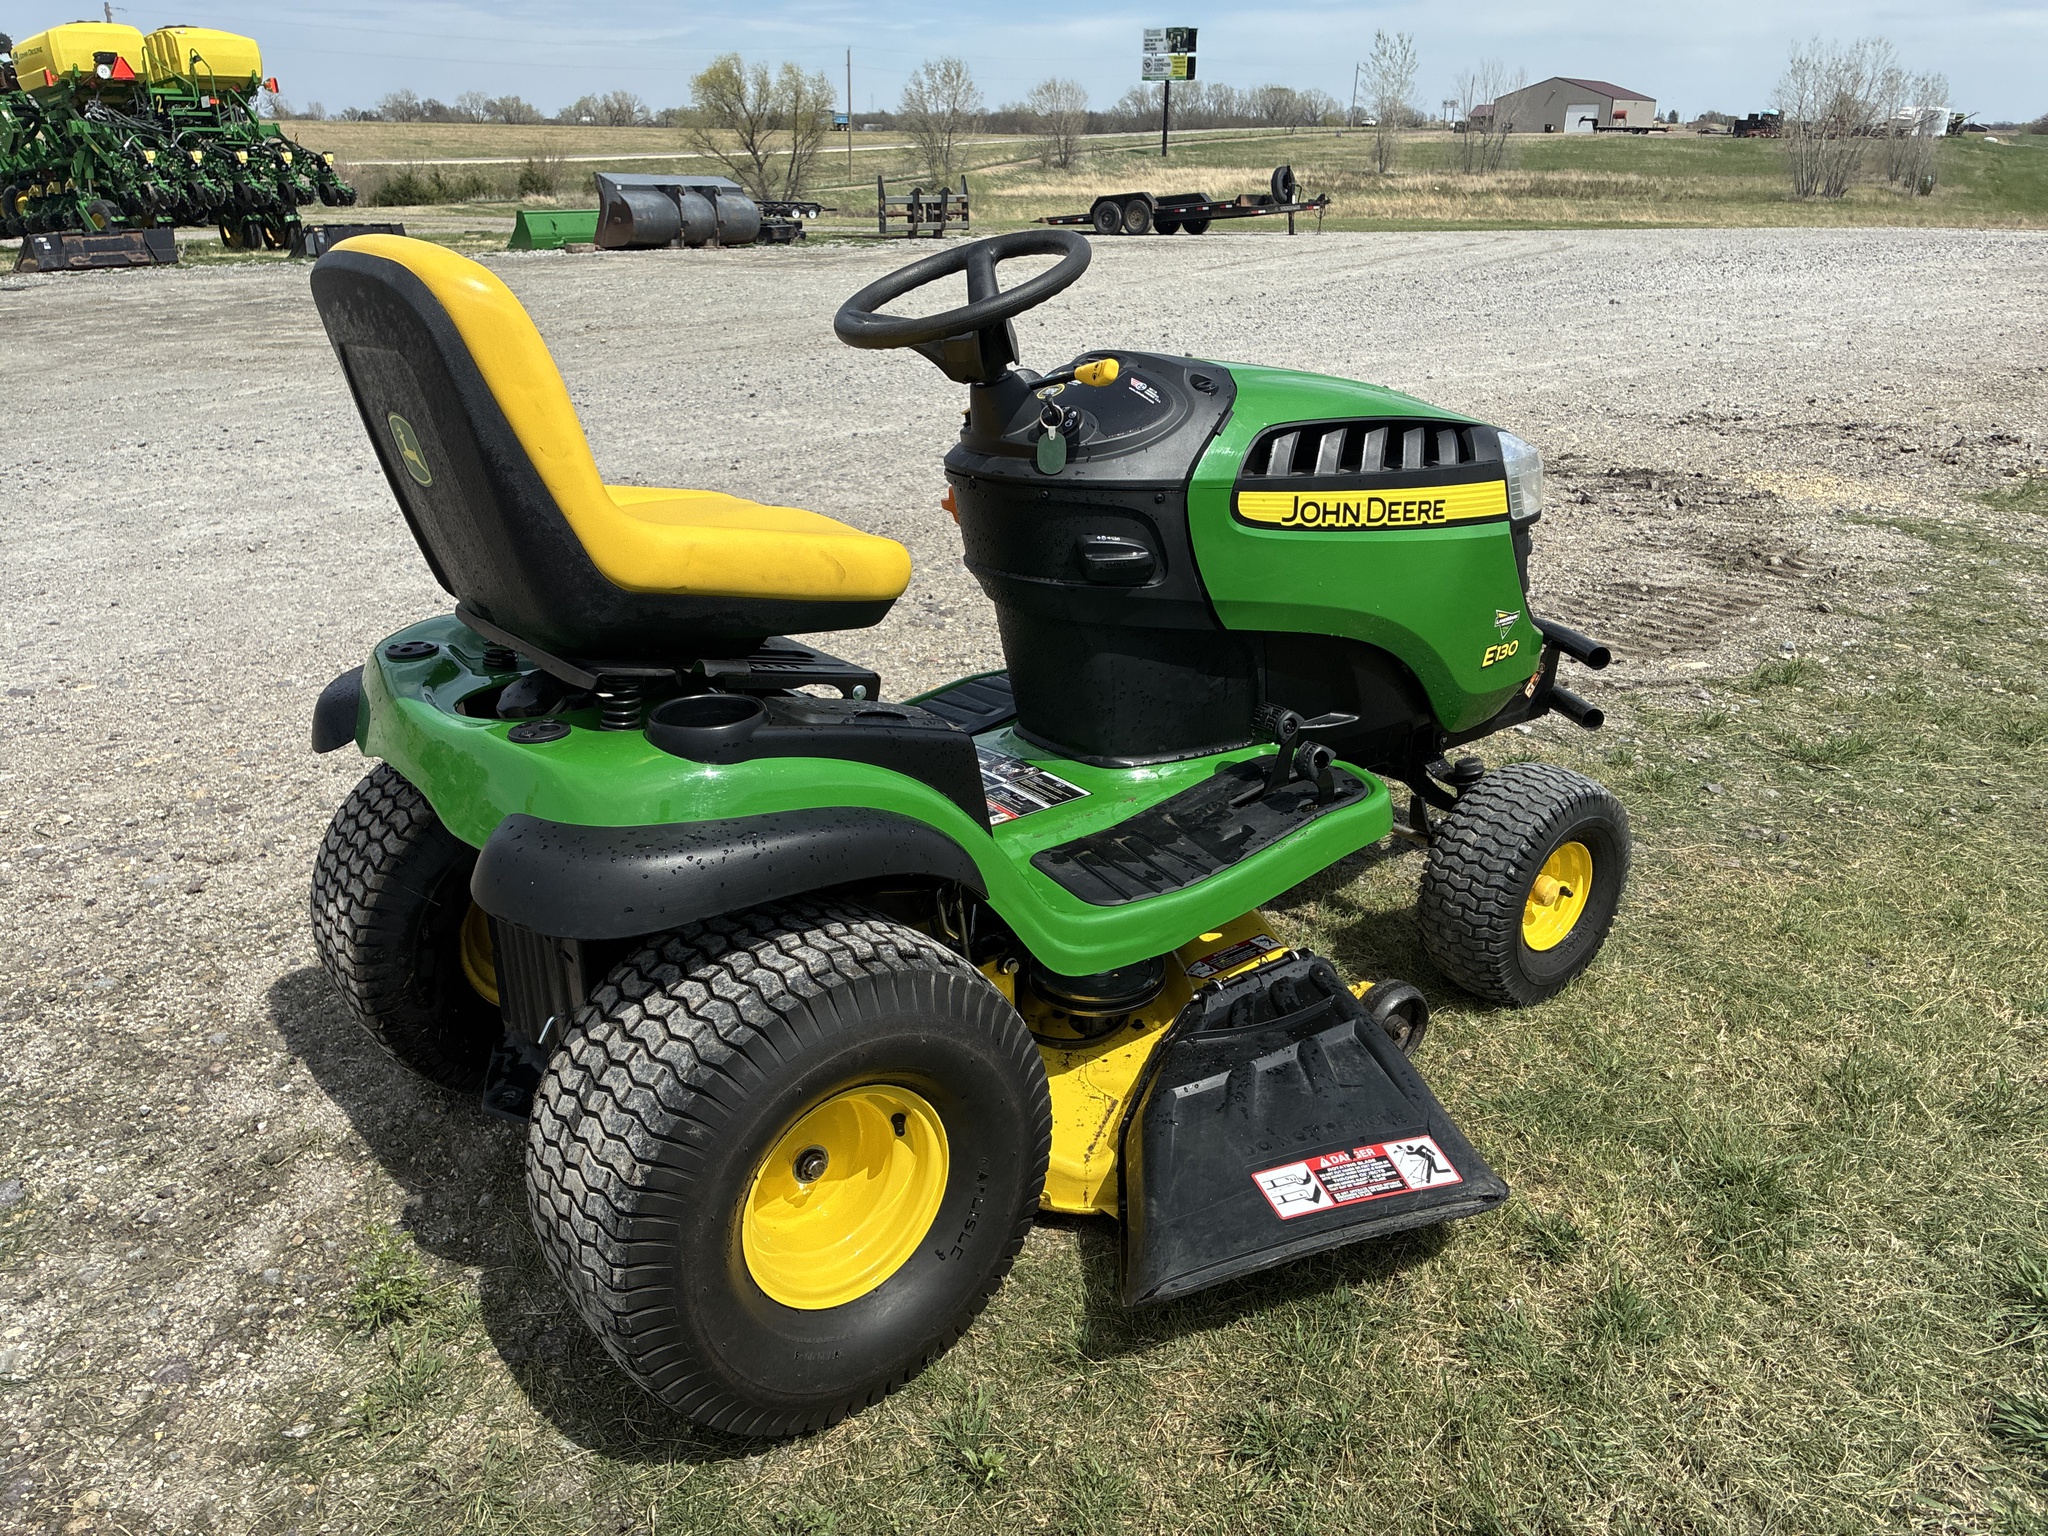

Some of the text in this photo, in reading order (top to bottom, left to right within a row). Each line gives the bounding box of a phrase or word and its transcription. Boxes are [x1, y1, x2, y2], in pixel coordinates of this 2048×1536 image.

[1281, 495, 1446, 524] JOHN DEERE
[1481, 639, 1519, 668] E130
